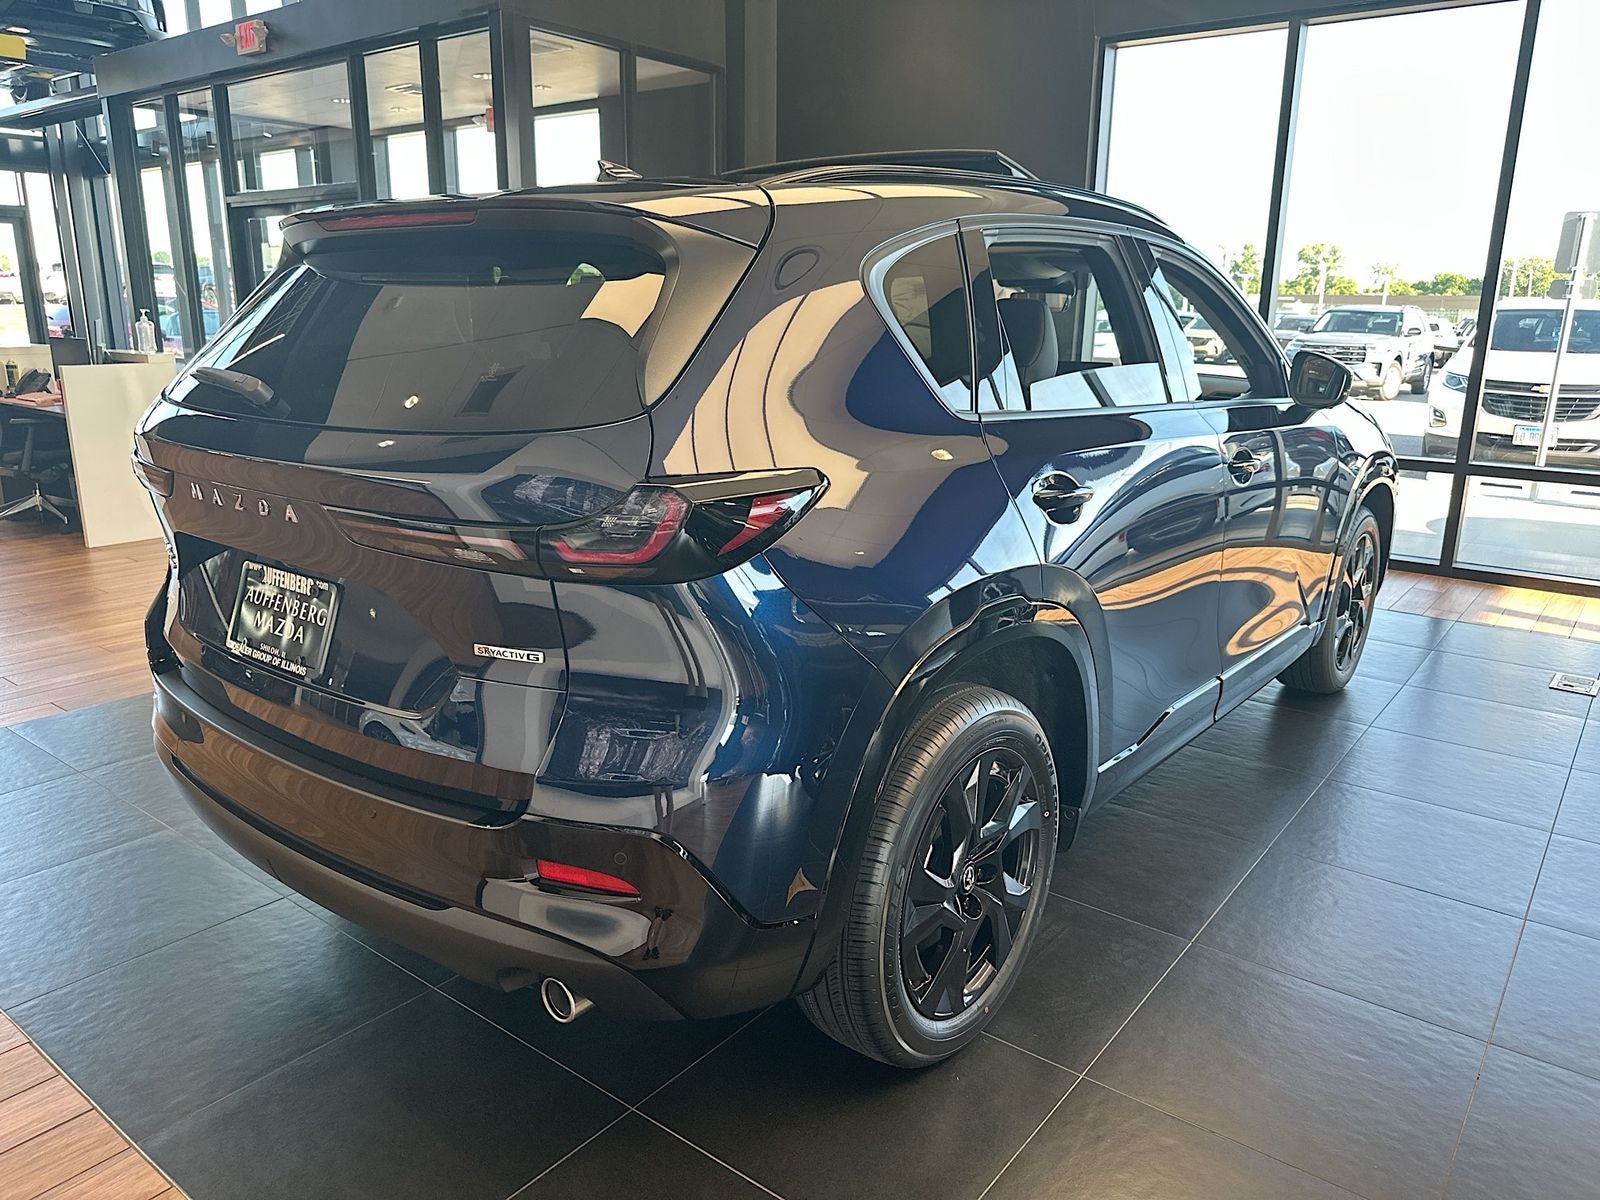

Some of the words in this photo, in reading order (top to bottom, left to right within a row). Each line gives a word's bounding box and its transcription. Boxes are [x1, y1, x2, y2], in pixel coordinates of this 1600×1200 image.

[190, 482, 299, 524] MAZDA
[244, 585, 328, 627] AUFFENBERG
[253, 610, 305, 644] MAZDA
[252, 649, 273, 663] GROUP
[272, 656, 281, 667] OF
[280, 659, 308, 676] ILLINOIS
